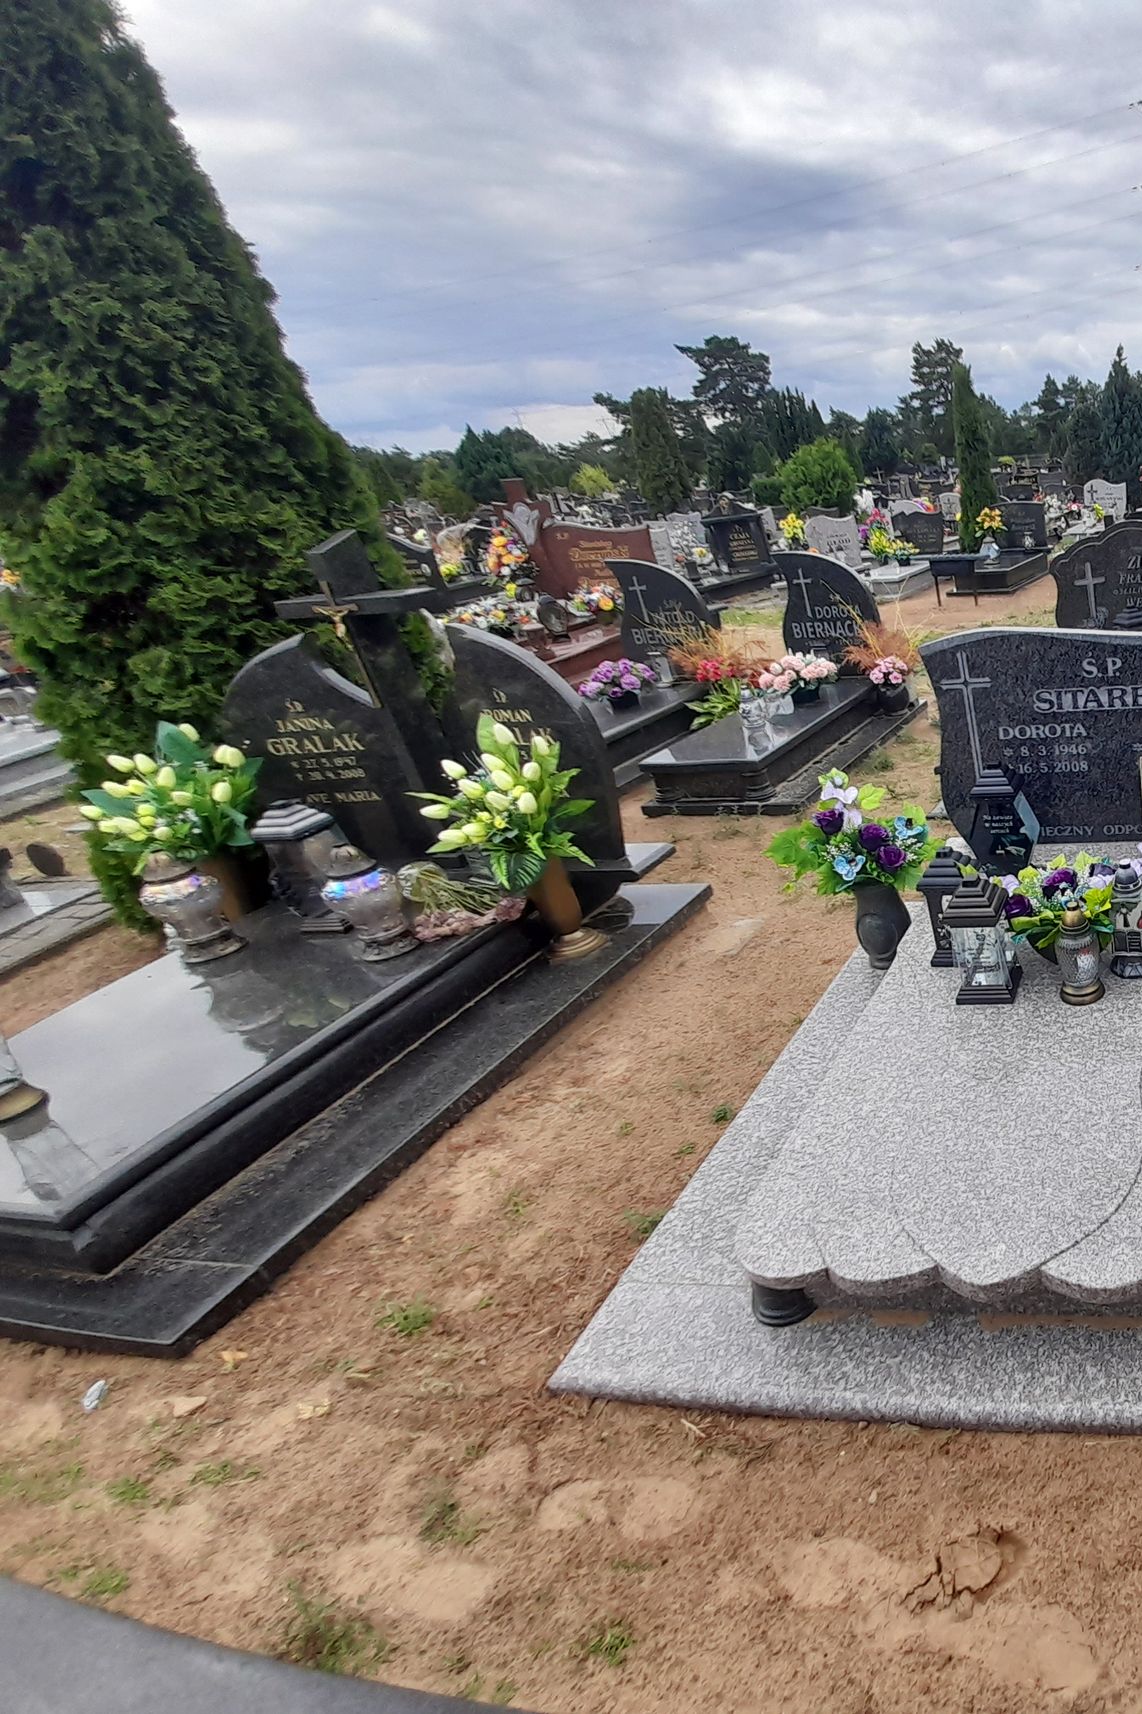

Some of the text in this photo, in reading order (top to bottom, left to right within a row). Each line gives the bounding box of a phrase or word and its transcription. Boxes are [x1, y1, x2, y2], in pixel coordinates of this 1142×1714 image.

[1082, 651, 1122, 678] Ś.P.
[275, 717, 335, 733] JANINA
[998, 723, 1088, 740] DOROTA
[266, 733, 366, 756] GRALAK
[304, 791, 380, 804] AVE MARIA
[1040, 826, 1095, 837] IECZNY
